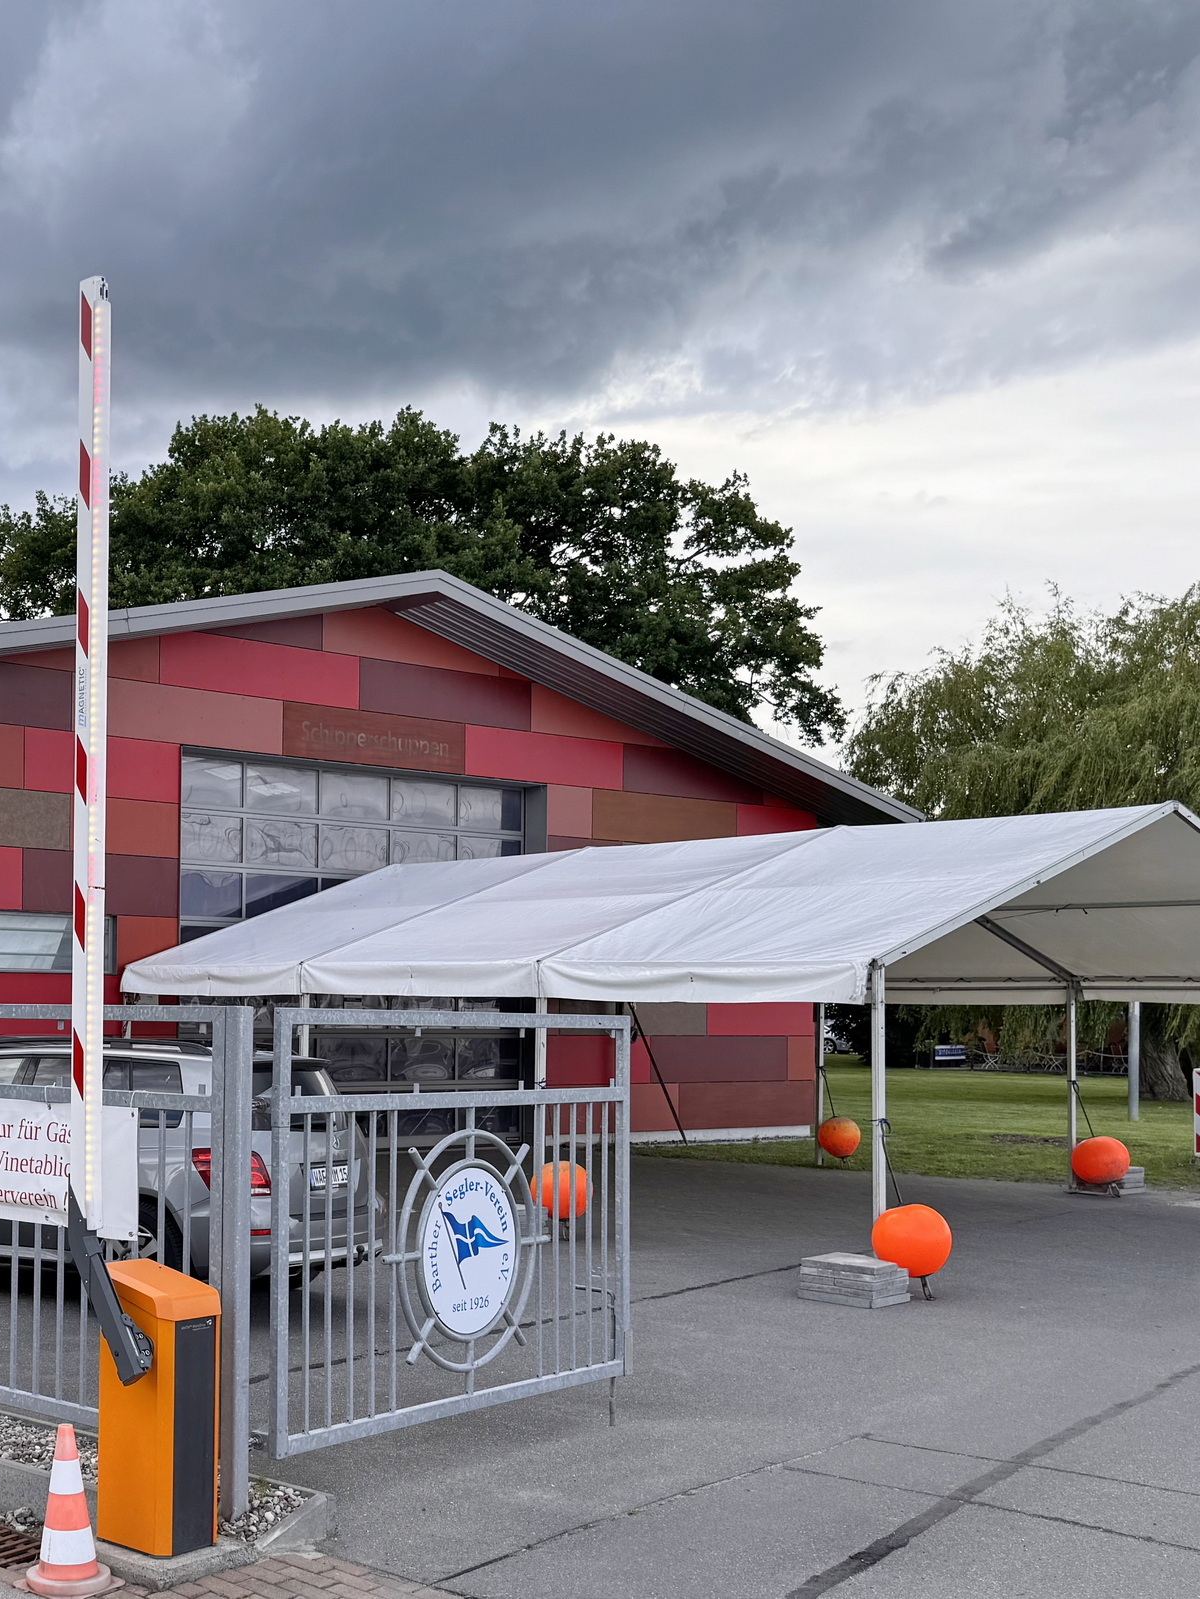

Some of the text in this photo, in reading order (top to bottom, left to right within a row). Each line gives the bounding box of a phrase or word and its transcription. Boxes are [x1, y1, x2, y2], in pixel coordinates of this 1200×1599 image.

[302, 721, 449, 757] Schipperschuppen
[17, 1118, 42, 1140] für
[46, 1121, 72, 1144] Gäs
[428, 1219, 443, 1295] Barther
[444, 1177, 509, 1233] Segler-Verein
[452, 1294, 490, 1313] seit 1926
